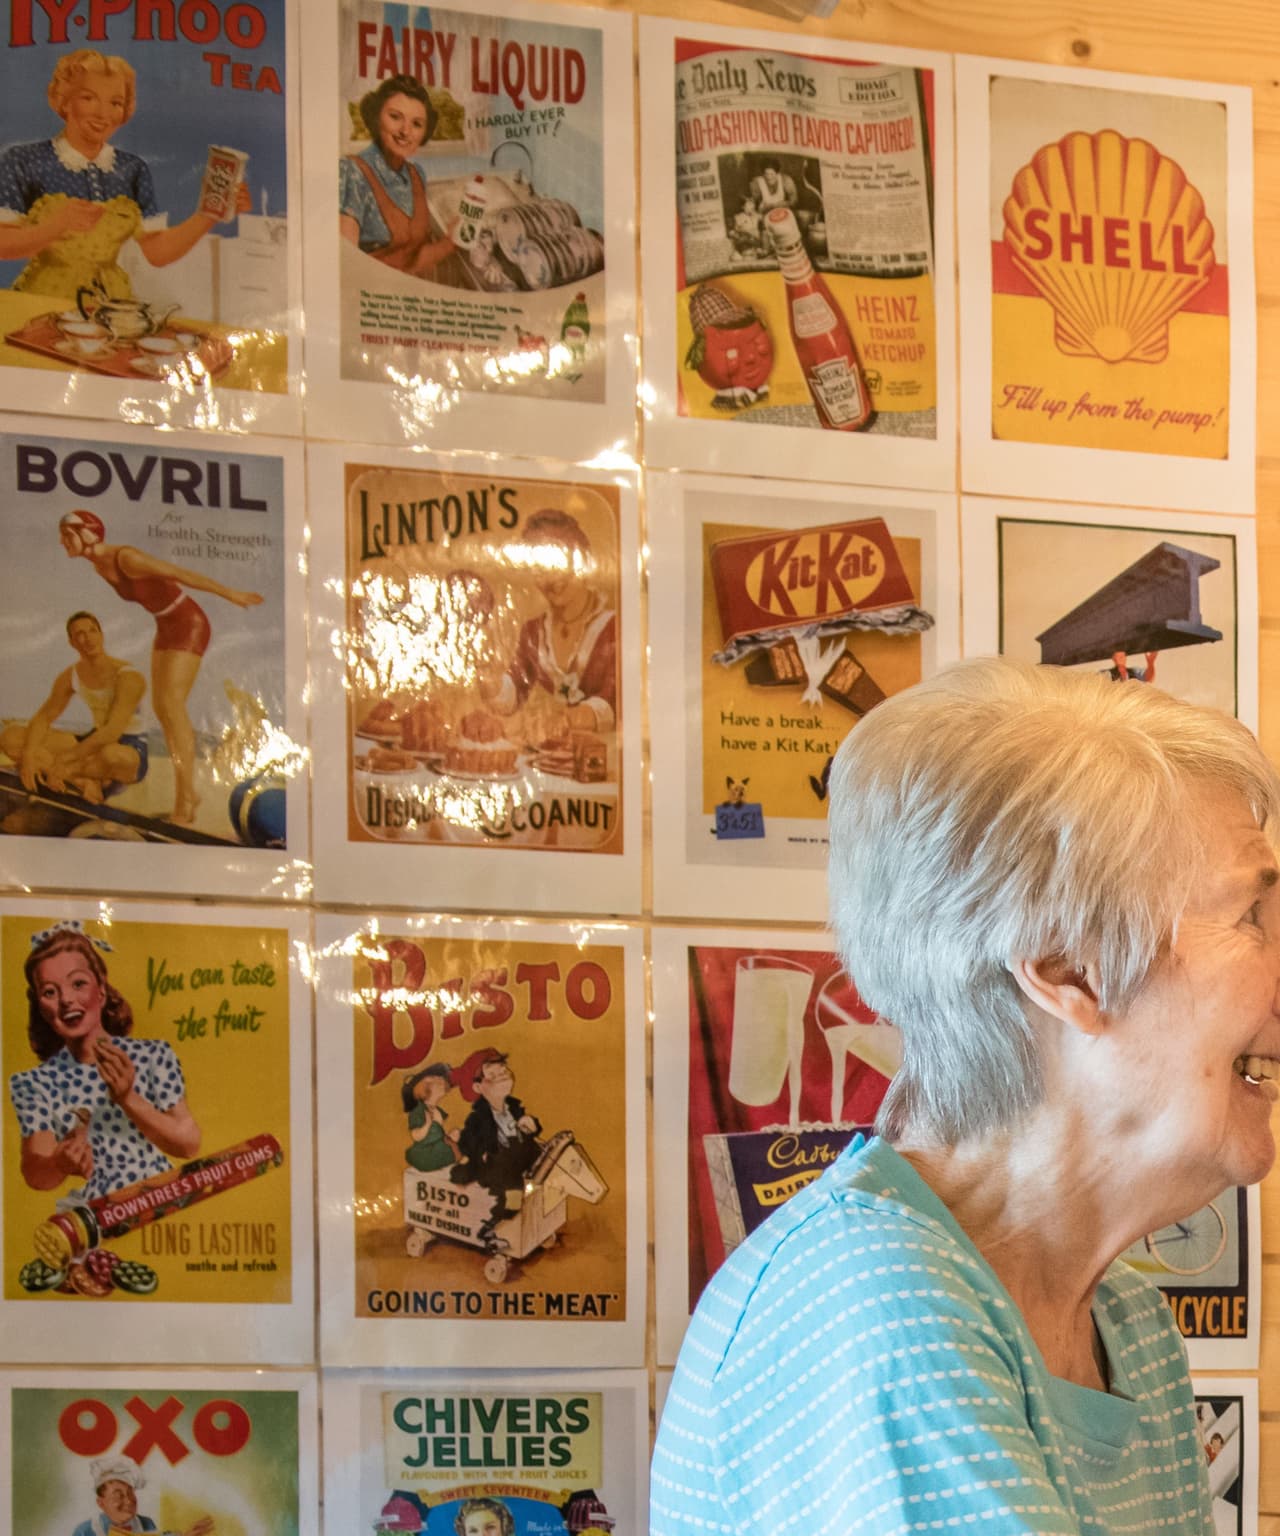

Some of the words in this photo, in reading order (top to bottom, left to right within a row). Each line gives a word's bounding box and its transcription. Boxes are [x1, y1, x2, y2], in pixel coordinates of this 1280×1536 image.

[202, 52, 283, 96] TEA
[357, 21, 457, 89] FAIRY
[471, 36, 586, 110] LIQUID
[691, 57, 749, 96] Daily
[754, 58, 818, 97] News
[475, 111, 525, 130] HARDLY
[529, 106, 566, 122] EVER
[504, 127, 531, 139] BUY
[679, 110, 790, 155] OLD-FASHIONED
[792, 113, 842, 152] FLAVOR
[845, 115, 917, 155] CAPTURED!
[1023, 207, 1199, 276] SHELL
[855, 294, 920, 324] HEINZ
[868, 327, 917, 341] TOMATO
[862, 342, 927, 364] KETCHUP
[997, 383, 1044, 412] Fill
[1041, 398, 1067, 422] up
[1067, 391, 1119, 422] from
[1123, 397, 1154, 422] the
[1152, 407, 1225, 433] pump!
[16, 444, 268, 512] BOVRIL
[160, 510, 185, 525] for
[359, 484, 520, 562] LINTON'S
[170, 543, 201, 558] and
[205, 527, 272, 548] Strength
[720, 711, 761, 727] Have
[766, 717, 774, 728] a
[720, 736, 757, 751] have
[762, 741, 771, 751] a
[776, 737, 800, 753] Kit
[147, 956, 184, 1011] You
[190, 967, 224, 990] can
[230, 959, 276, 988] taste
[173, 1006, 207, 1042] the
[213, 998, 267, 1039] fruit
[368, 939, 612, 1086] BISTO
[101, 1177, 193, 1226] ROWNTREE'S
[193, 1162, 233, 1189] FRUIT
[234, 1144, 274, 1171] GUMS
[416, 1180, 470, 1208] BISTO
[425, 1201, 442, 1214] for
[445, 1209, 460, 1219] all
[140, 1222, 191, 1257] LONG
[200, 1222, 277, 1257] LASTING
[221, 1259, 239, 1272] and
[242, 1258, 278, 1272] refresh
[367, 1290, 446, 1314] GOING
[450, 1292, 483, 1315] TO
[487, 1292, 537, 1316] THE
[1163, 1294, 1246, 1335] ICYCLE
[57, 1394, 252, 1468] OXO
[393, 1397, 590, 1434] CHIVERS
[402, 1435, 572, 1468] JELLIES
[463, 1470, 488, 1480] WITH
[519, 1470, 549, 1480] FRUIT
[552, 1469, 588, 1480] JUICES
[439, 1486, 476, 1501] SWEET
[482, 1484, 550, 1501] SEVENTEEN
